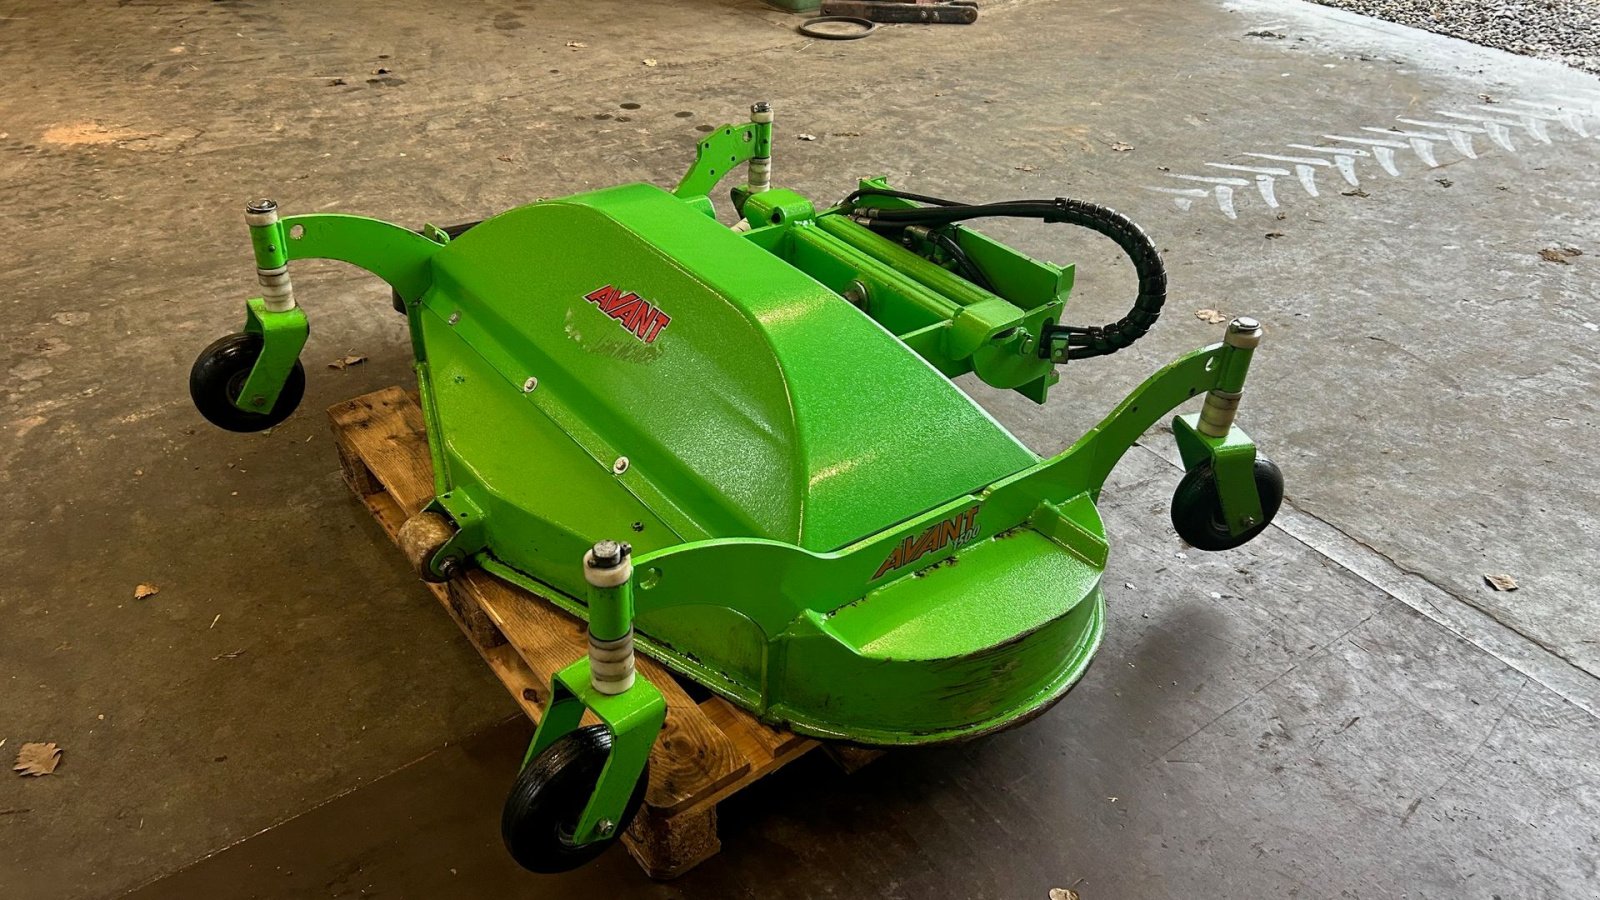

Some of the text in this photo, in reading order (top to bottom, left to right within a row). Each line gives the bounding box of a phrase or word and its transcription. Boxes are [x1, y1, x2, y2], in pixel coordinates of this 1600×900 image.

[583, 284, 671, 343] AVANT
[869, 505, 979, 581] AVANT
[953, 525, 980, 550] 1500
